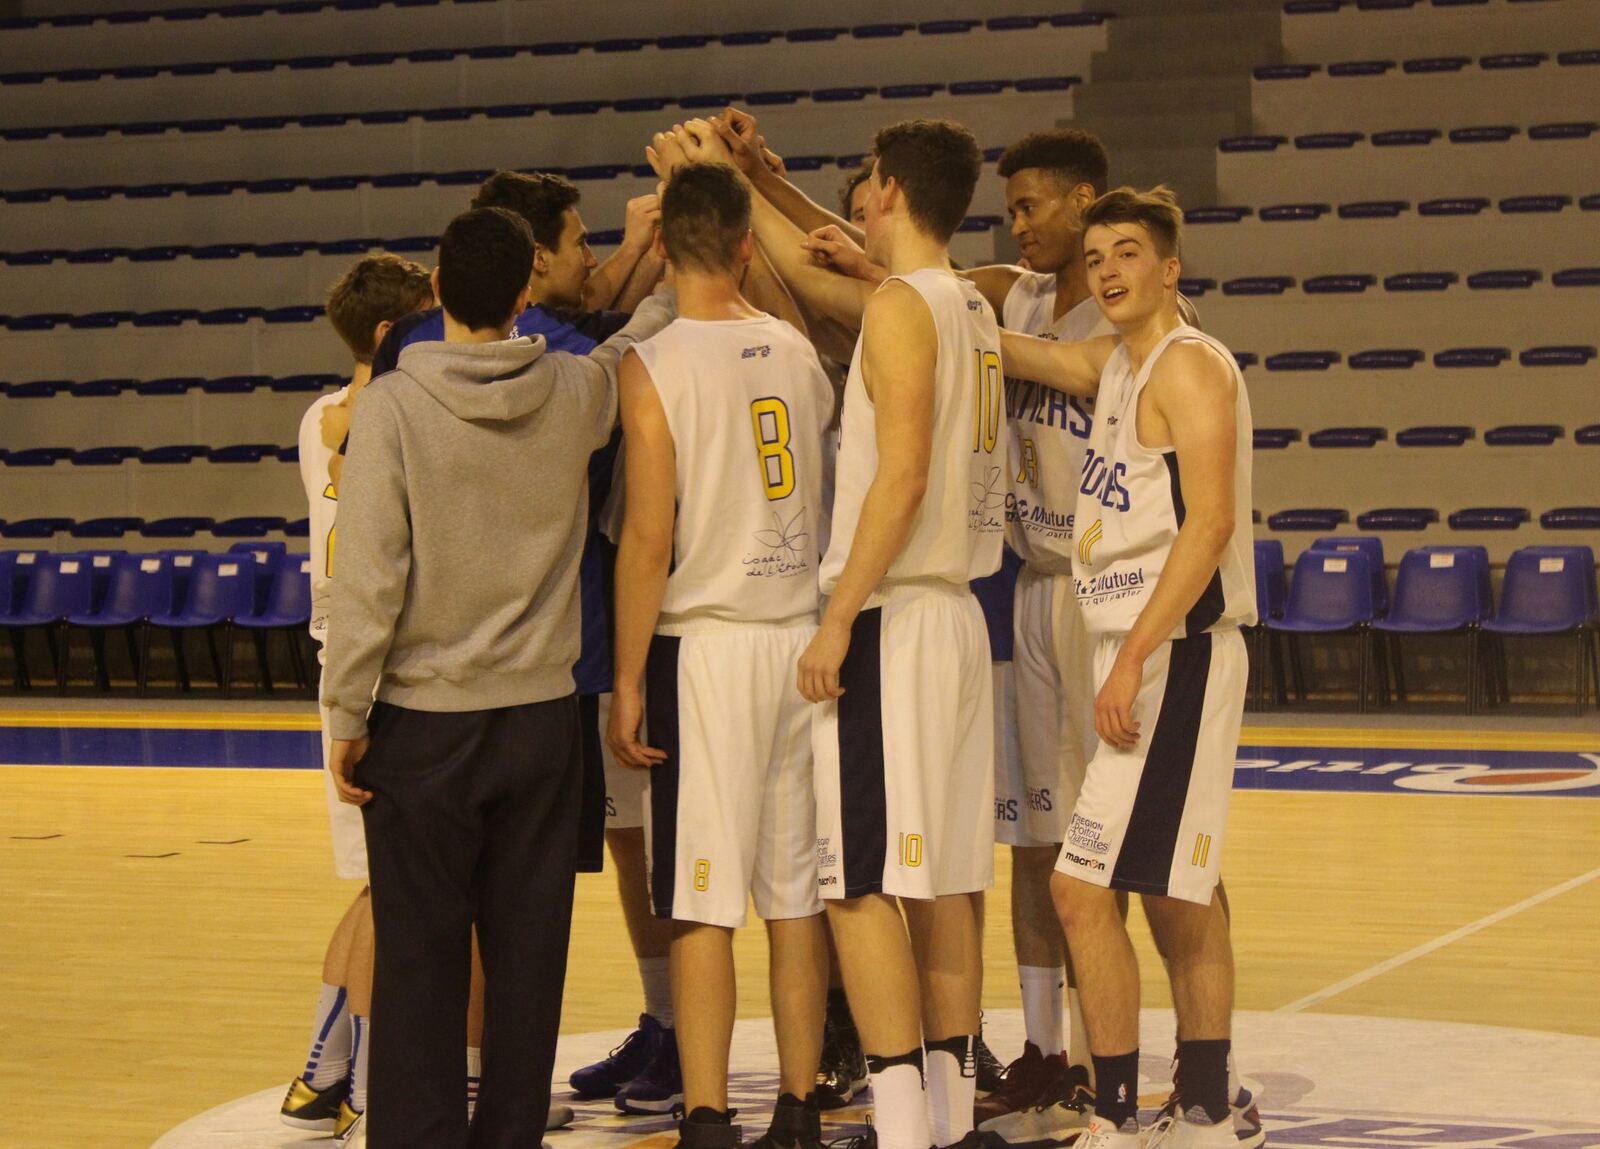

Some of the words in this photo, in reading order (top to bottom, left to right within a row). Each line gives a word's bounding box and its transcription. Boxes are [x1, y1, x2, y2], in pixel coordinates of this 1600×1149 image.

[973, 348, 1001, 454] 10
[751, 396, 796, 501] 8
[1030, 506, 1076, 528] Mutue
[899, 831, 923, 868] 10
[1065, 852, 1106, 871] macron
[1191, 832, 1212, 868] 11
[693, 858, 711, 892] 8
